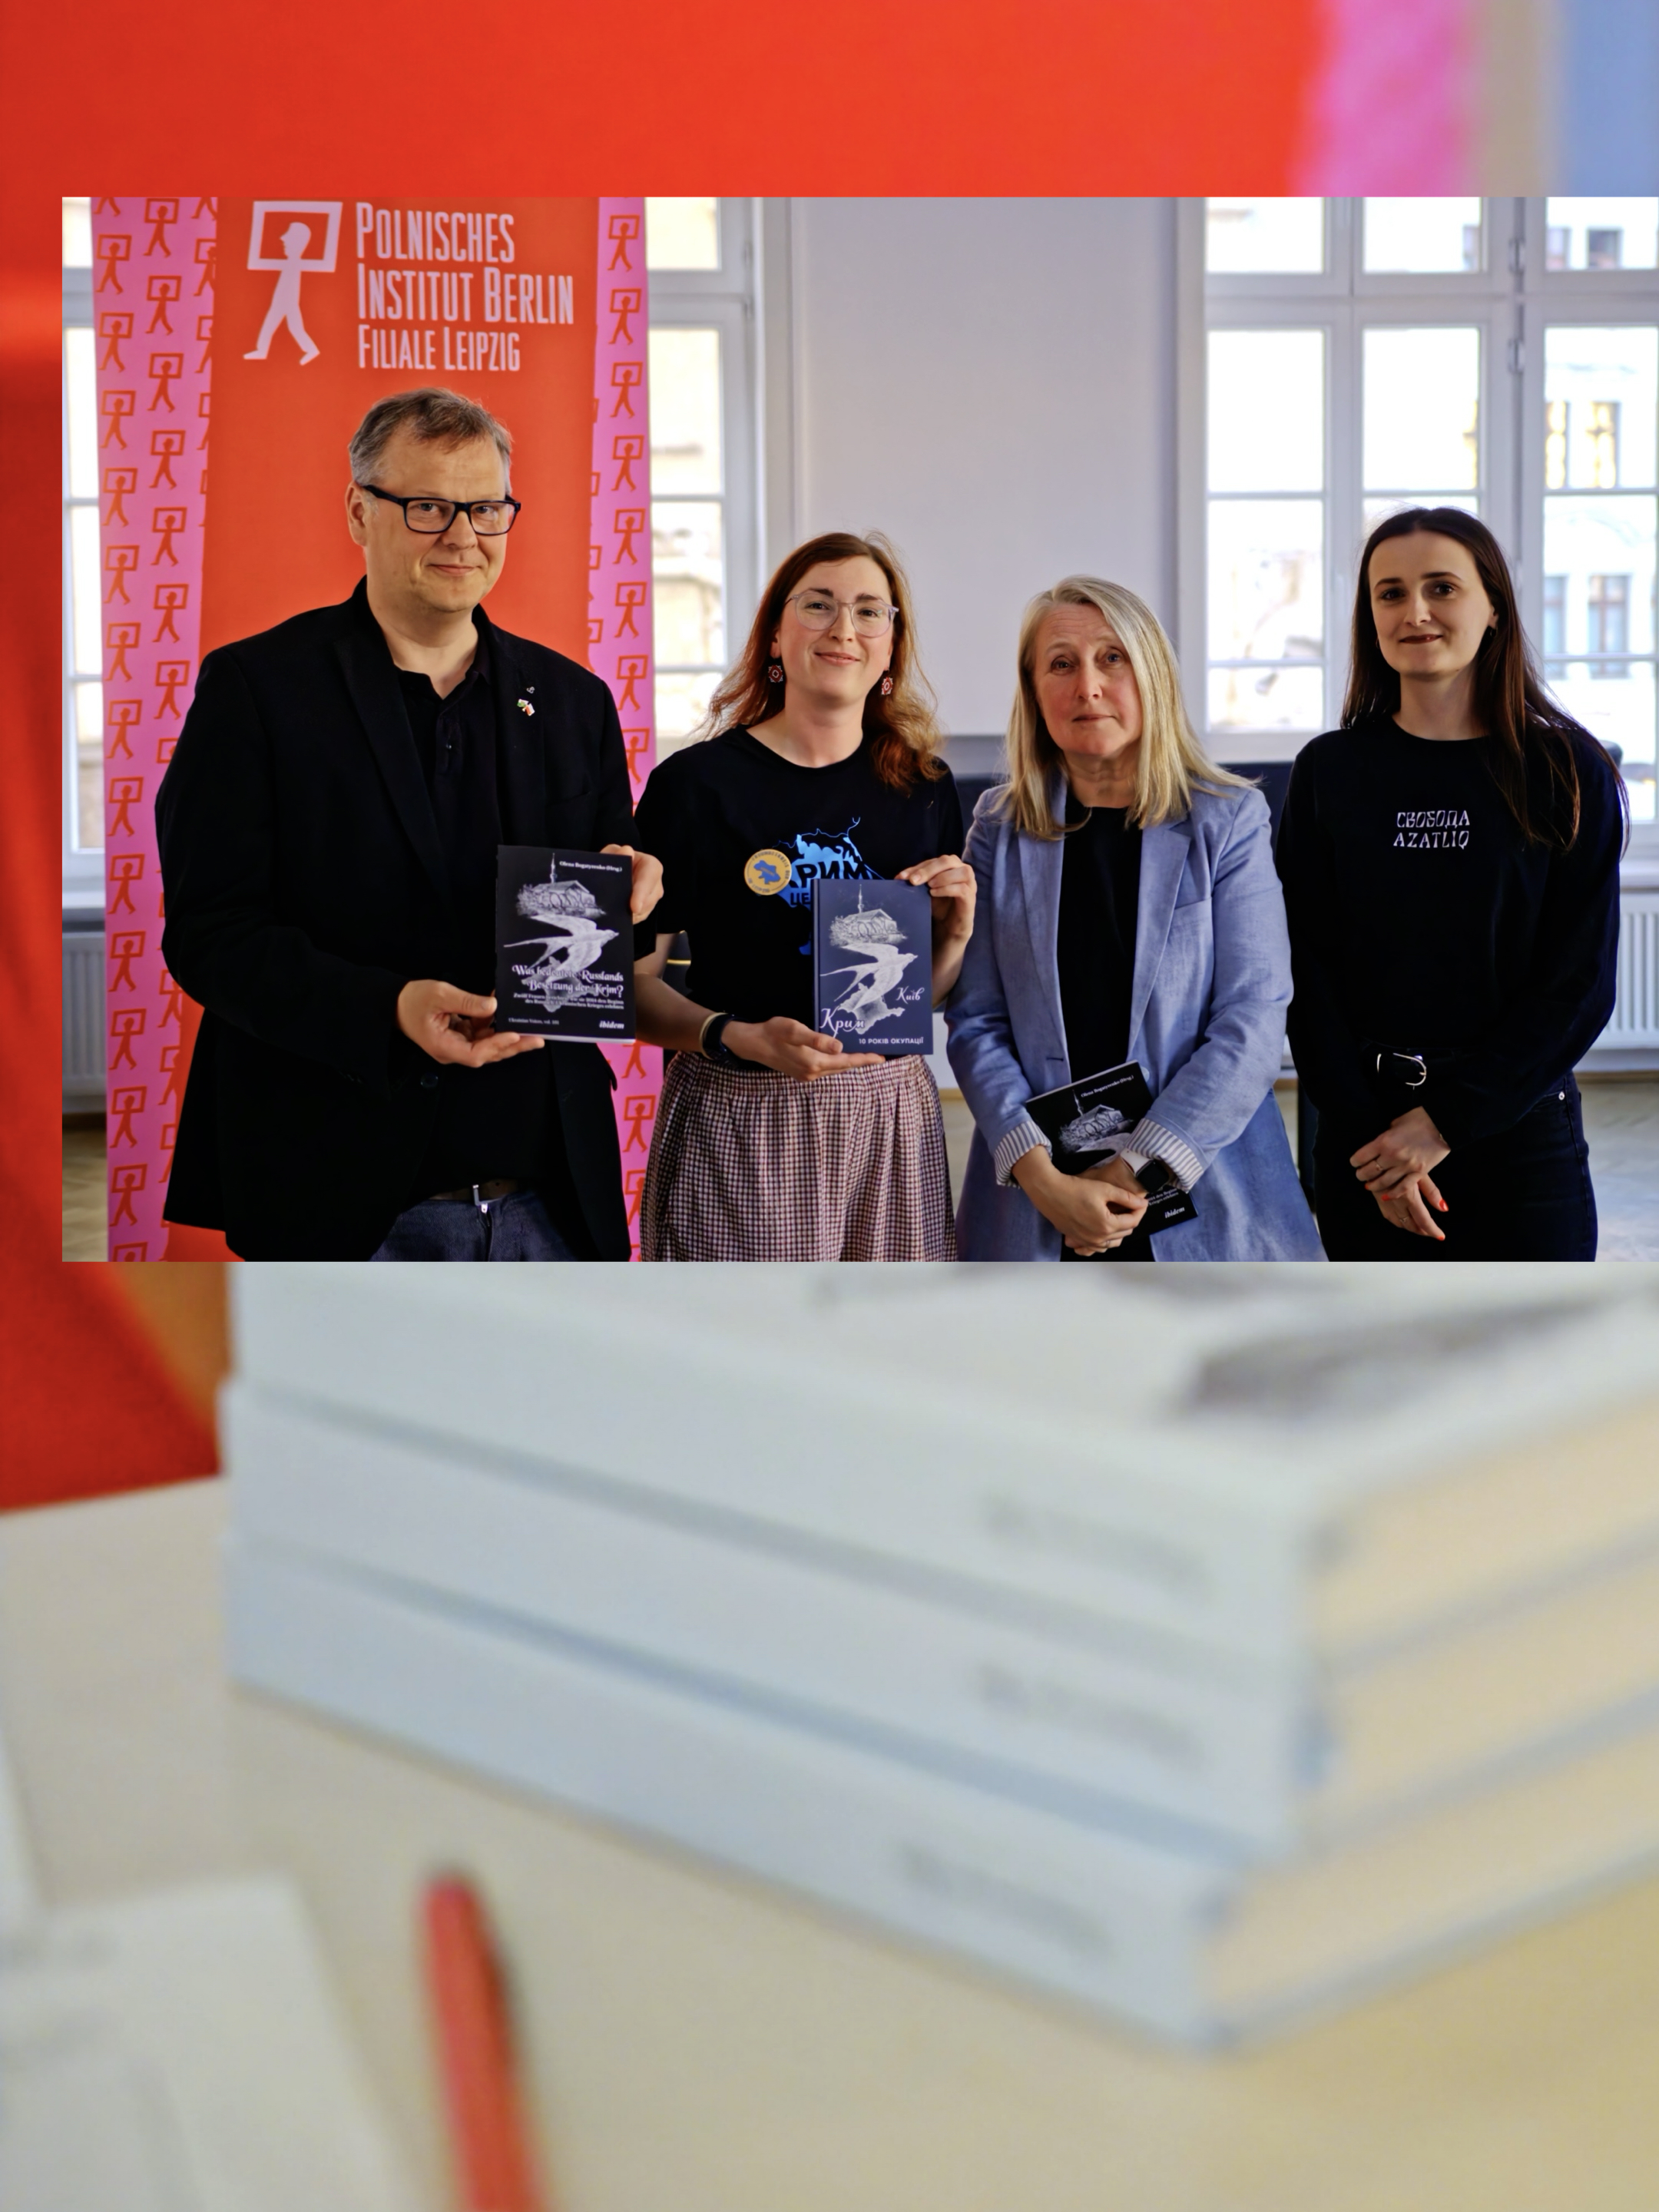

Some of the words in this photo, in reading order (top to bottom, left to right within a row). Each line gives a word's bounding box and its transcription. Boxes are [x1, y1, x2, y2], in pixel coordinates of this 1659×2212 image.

[356, 201, 515, 263] POLNISCHES
[357, 263, 474, 323] INSTITUT
[483, 266, 575, 324] BERLIN
[358, 323, 437, 369] FILIALE
[443, 326, 521, 372] LEIPZIG
[1396, 810, 1470, 830] СВОБОДА
[1392, 830, 1469, 849] AZATLIQ
[789, 859, 871, 888] РИМ
[512, 965, 535, 976] Was
[579, 969, 624, 984] Russlands
[528, 979, 574, 994] Besetzung
[575, 982, 589, 992] der
[592, 983, 624, 998] Krim?
[896, 985, 926, 1005] Київ
[599, 1020, 624, 1029] ibidem
[820, 1005, 866, 1038] Крим
[890, 1037, 924, 1045] ОКУПАЦІЇ
[1164, 1207, 1185, 1219] ibidem
